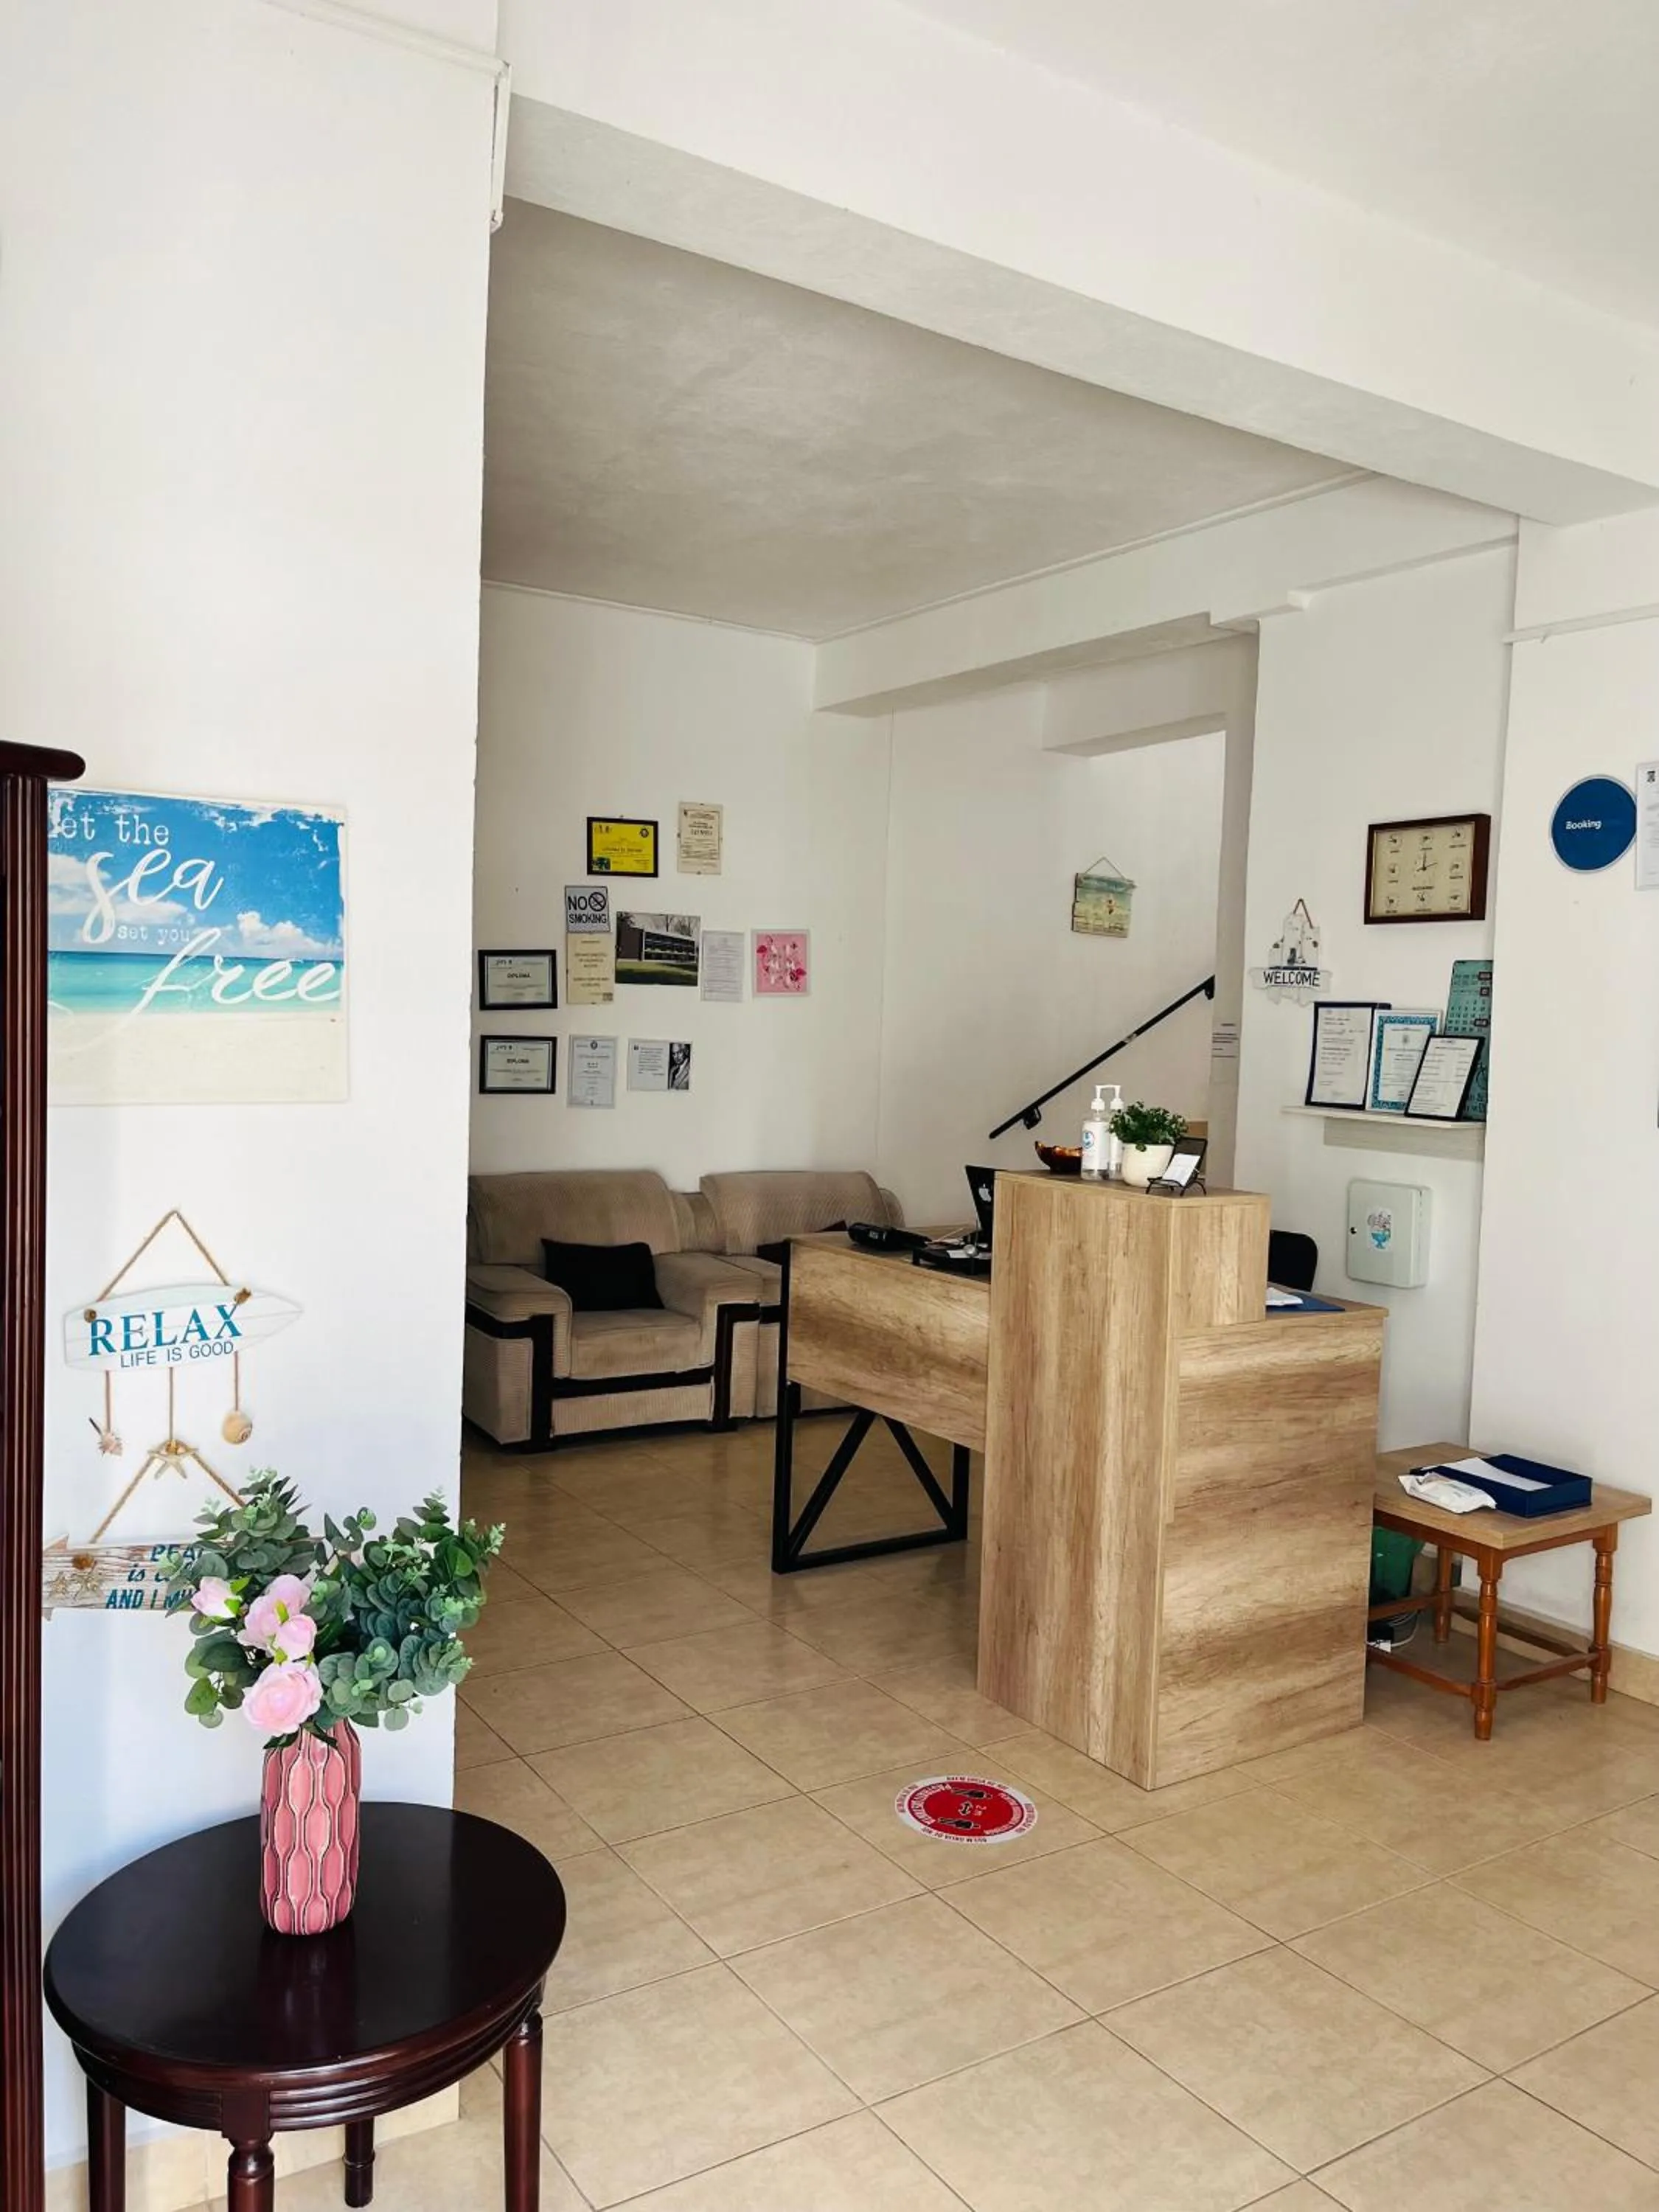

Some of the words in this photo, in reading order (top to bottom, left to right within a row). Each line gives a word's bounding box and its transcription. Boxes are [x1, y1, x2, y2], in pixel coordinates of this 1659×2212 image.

[115, 814, 169, 845] the
[1565, 819, 1601, 830] Booking
[568, 896, 587, 911] NO
[568, 914, 606, 924] SMOKING
[118, 925, 147, 940] set
[158, 928, 189, 945] you
[111, 927, 344, 1031] free
[1263, 971, 1320, 987] WELCOME
[88, 1304, 243, 1355] RELAX
[120, 1350, 156, 1367] LIFE
[167, 1347, 181, 1361] IS
[189, 1341, 234, 1358] GOOD
[128, 1563, 145, 1582] is
[105, 1589, 144, 1609] AND
[150, 1589, 158, 1609] I
